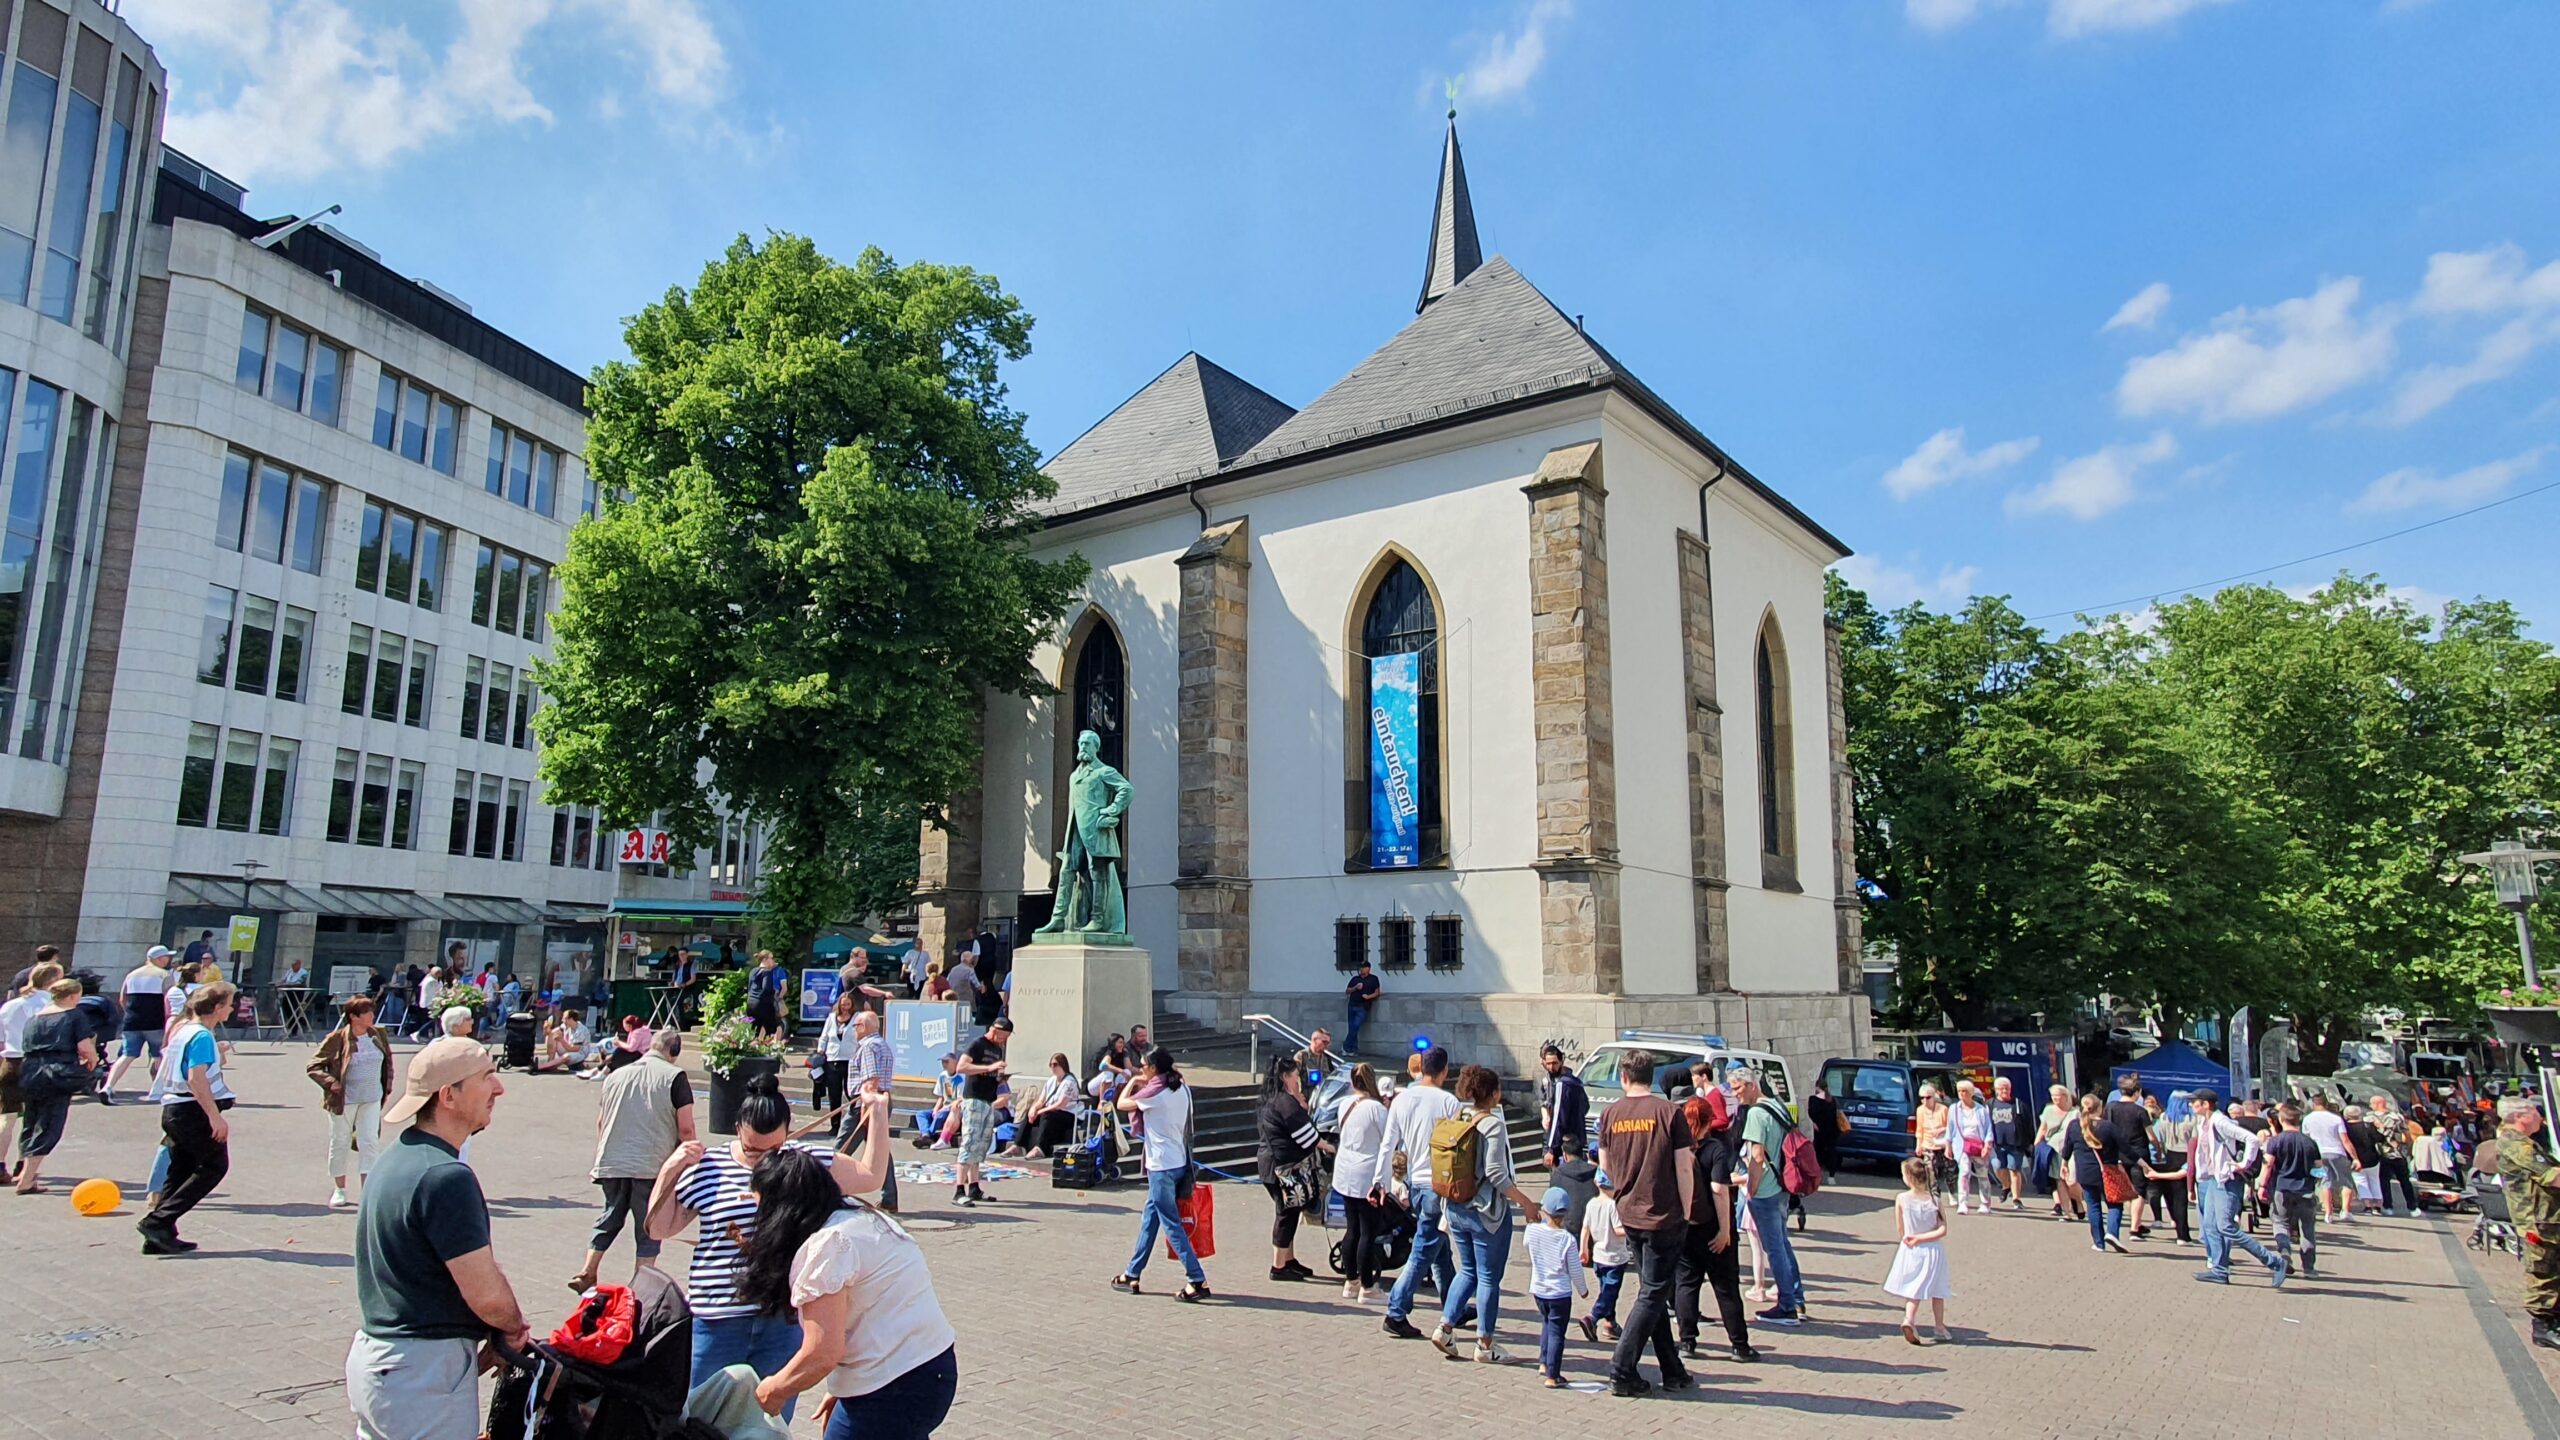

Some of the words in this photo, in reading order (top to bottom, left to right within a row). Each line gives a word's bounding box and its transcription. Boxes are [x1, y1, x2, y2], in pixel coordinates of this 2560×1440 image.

[1373, 708, 1416, 816] eintauchen!
[620, 830, 644, 860] A
[237, 919, 257, 928] WC
[923, 1021, 946, 1034] SPIEL
[1542, 1038, 1579, 1050] MAN
[1922, 1040, 1947, 1054] WC
[2002, 1042, 2028, 1056] WC
[1611, 1119, 1655, 1133] VARIANT
